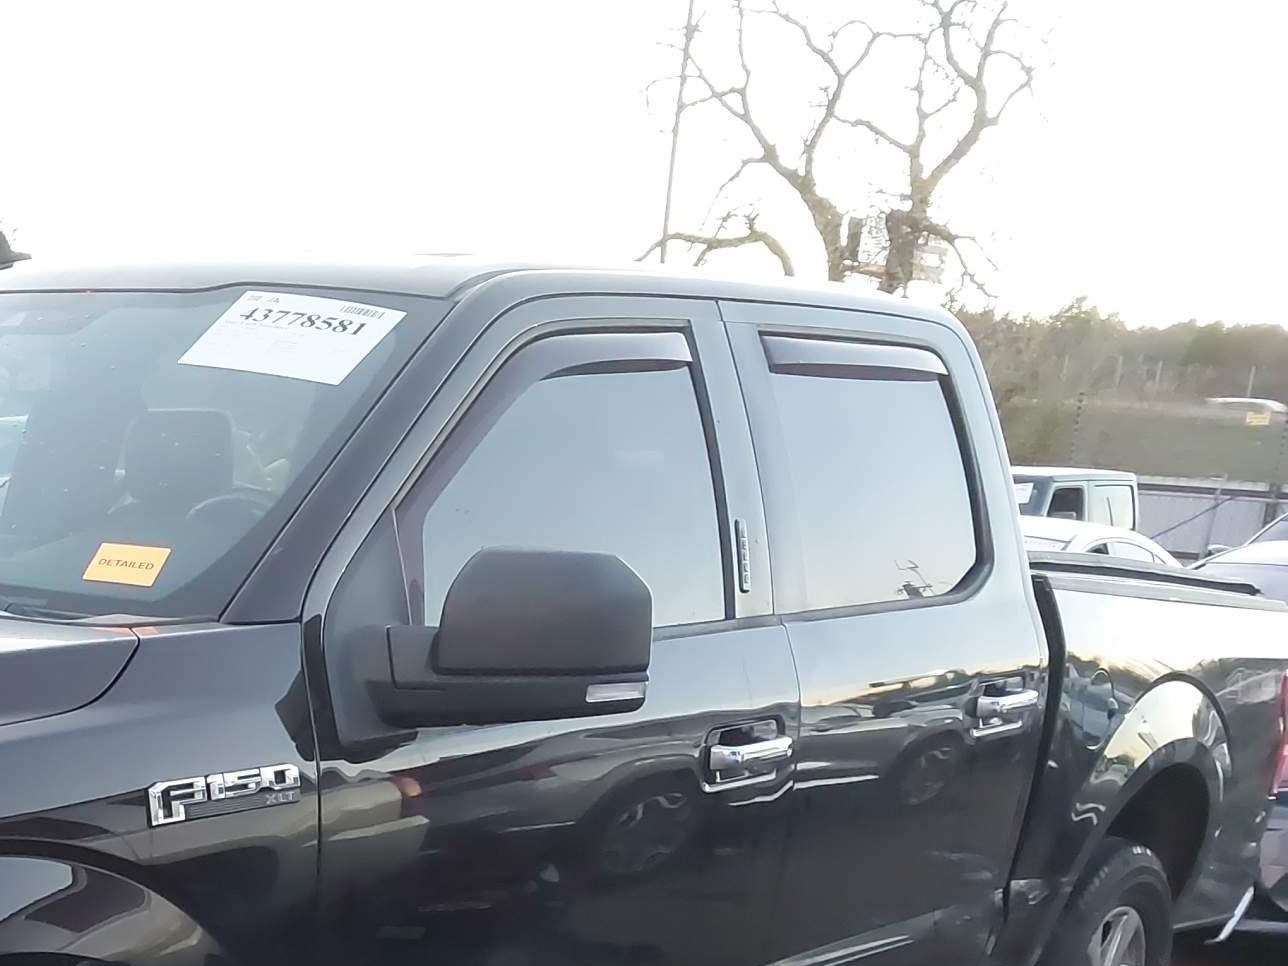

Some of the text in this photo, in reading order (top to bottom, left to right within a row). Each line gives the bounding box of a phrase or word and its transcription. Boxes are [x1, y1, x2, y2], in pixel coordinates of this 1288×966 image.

[239, 306, 368, 336] 43778581
[98, 558, 154, 570] DETAILED
[265, 790, 296, 805] XLT
